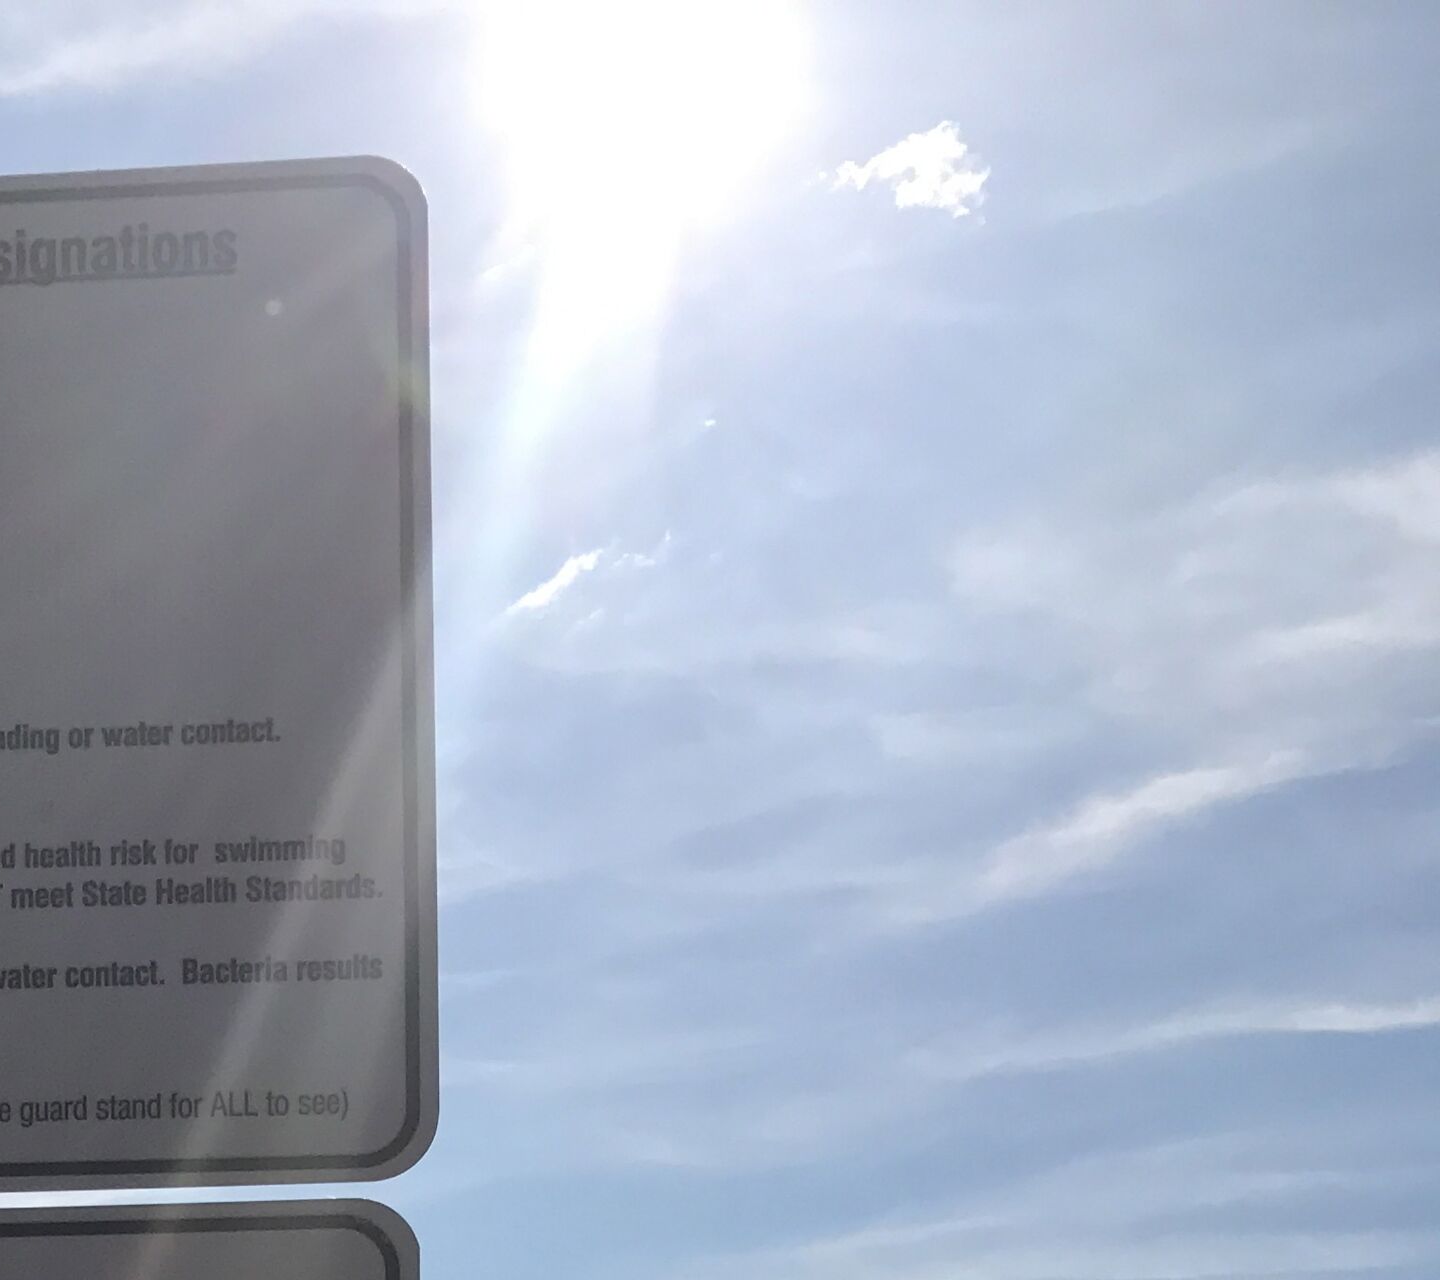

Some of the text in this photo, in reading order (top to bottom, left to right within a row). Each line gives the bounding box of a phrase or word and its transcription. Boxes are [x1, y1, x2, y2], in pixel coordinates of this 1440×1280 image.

[67, 727, 95, 749] or
[100, 722, 174, 747] water
[180, 718, 281, 745] contact.
[19, 1095, 88, 1128] guard
[95, 1093, 162, 1121] stand
